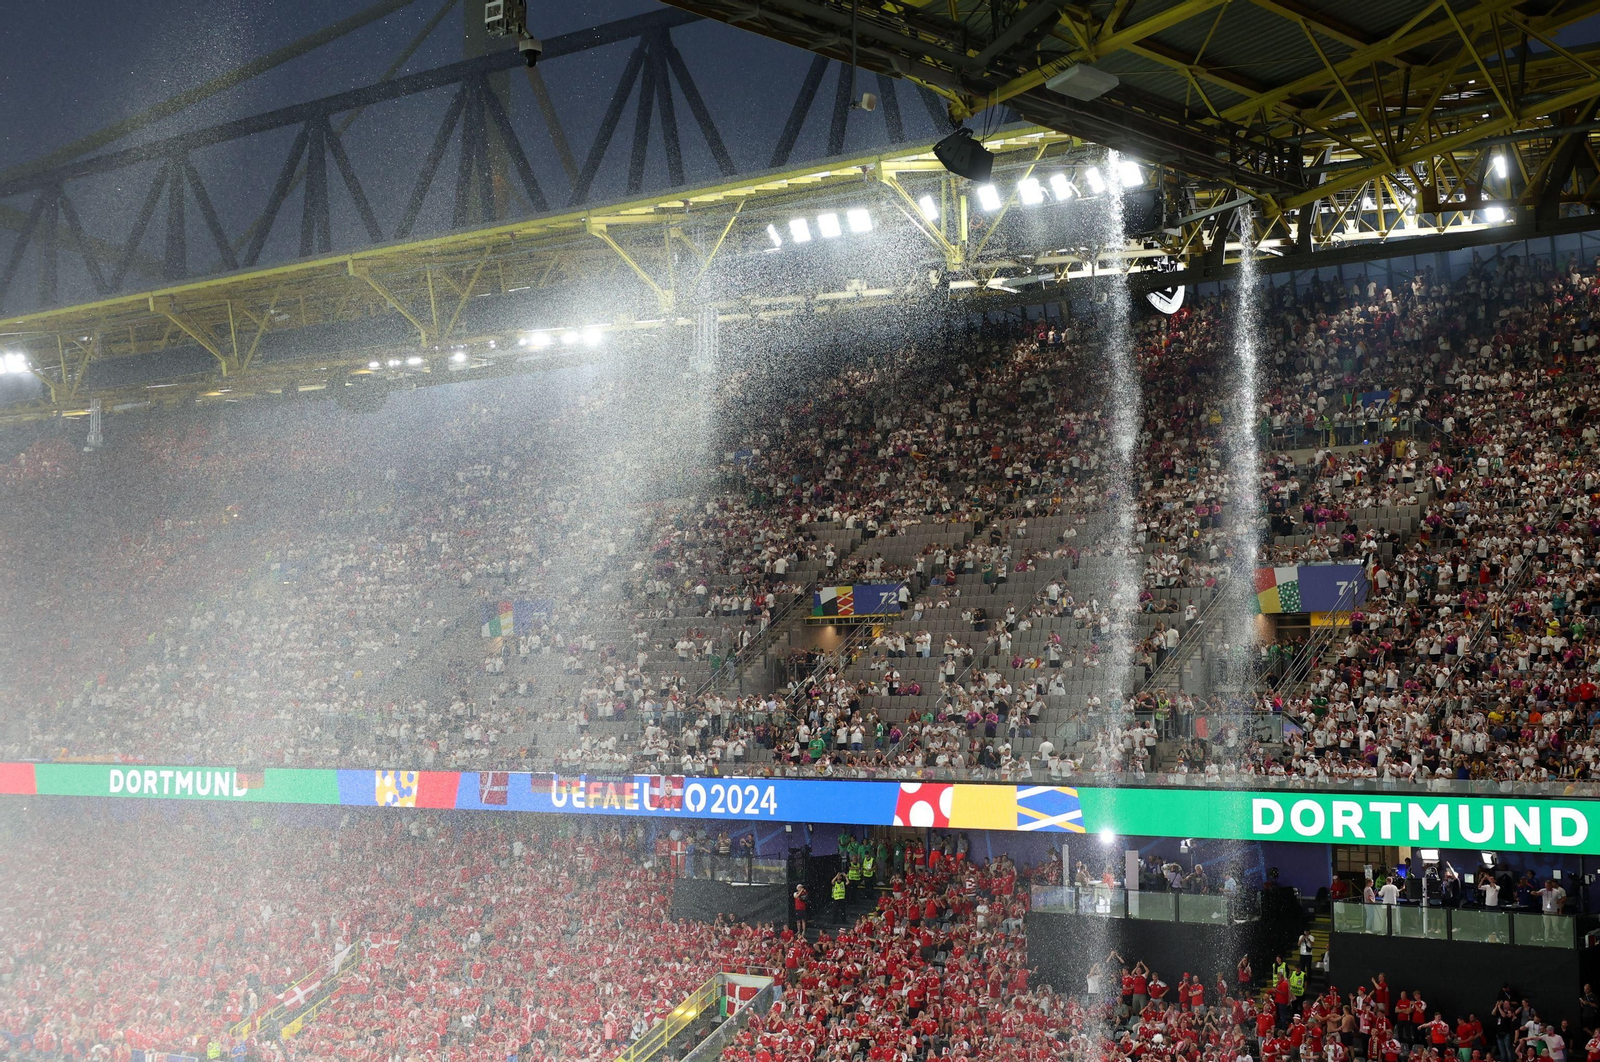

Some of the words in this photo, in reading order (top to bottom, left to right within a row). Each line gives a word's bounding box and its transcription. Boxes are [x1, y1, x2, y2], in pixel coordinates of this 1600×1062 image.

[879, 591, 898, 605] 72
[1336, 581, 1358, 596] 71
[109, 769, 248, 797] DORTMUND
[1252, 798, 1589, 847] DORTMUND
